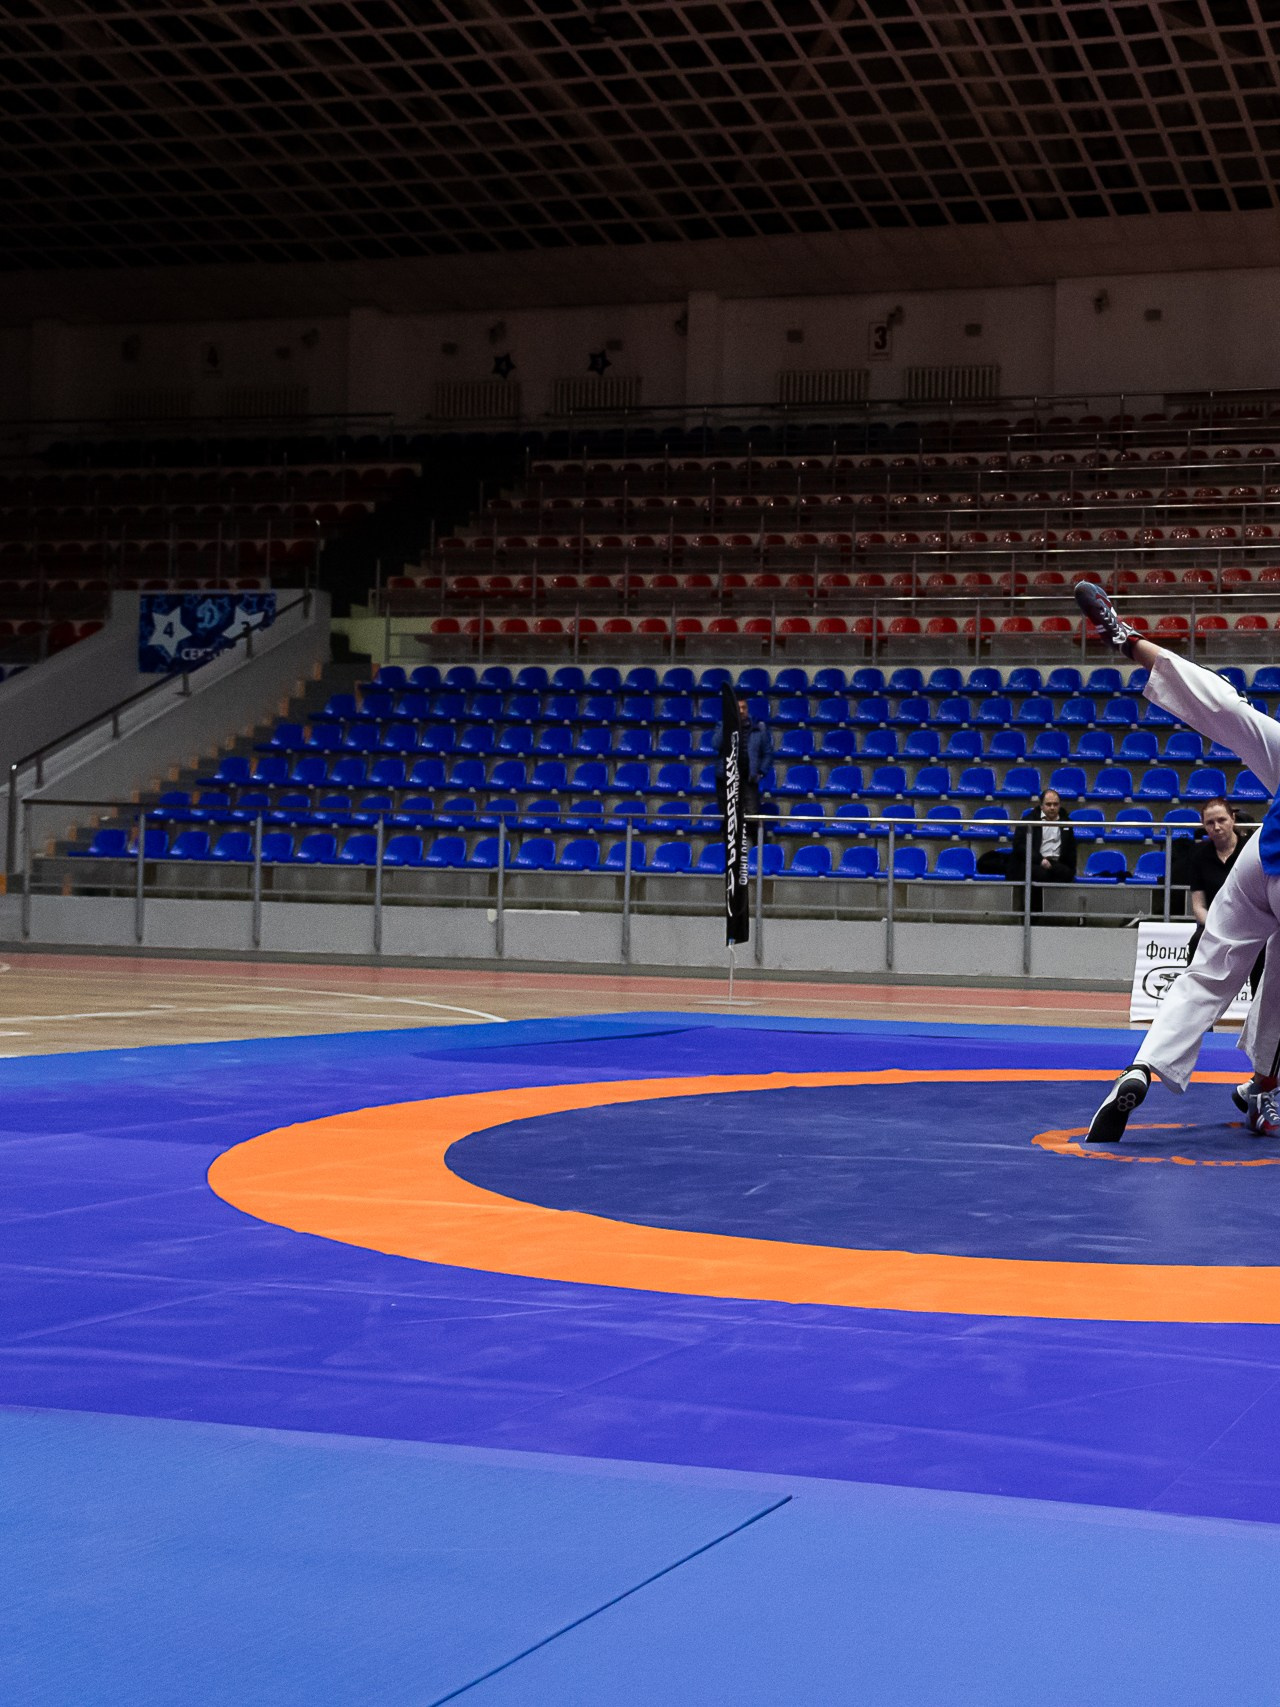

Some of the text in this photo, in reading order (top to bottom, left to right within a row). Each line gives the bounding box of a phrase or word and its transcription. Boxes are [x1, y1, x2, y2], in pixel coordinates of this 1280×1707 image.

[875, 327, 886, 349] 3
[163, 622, 174, 638] 4
[1146, 940, 1188, 962] Фонд
